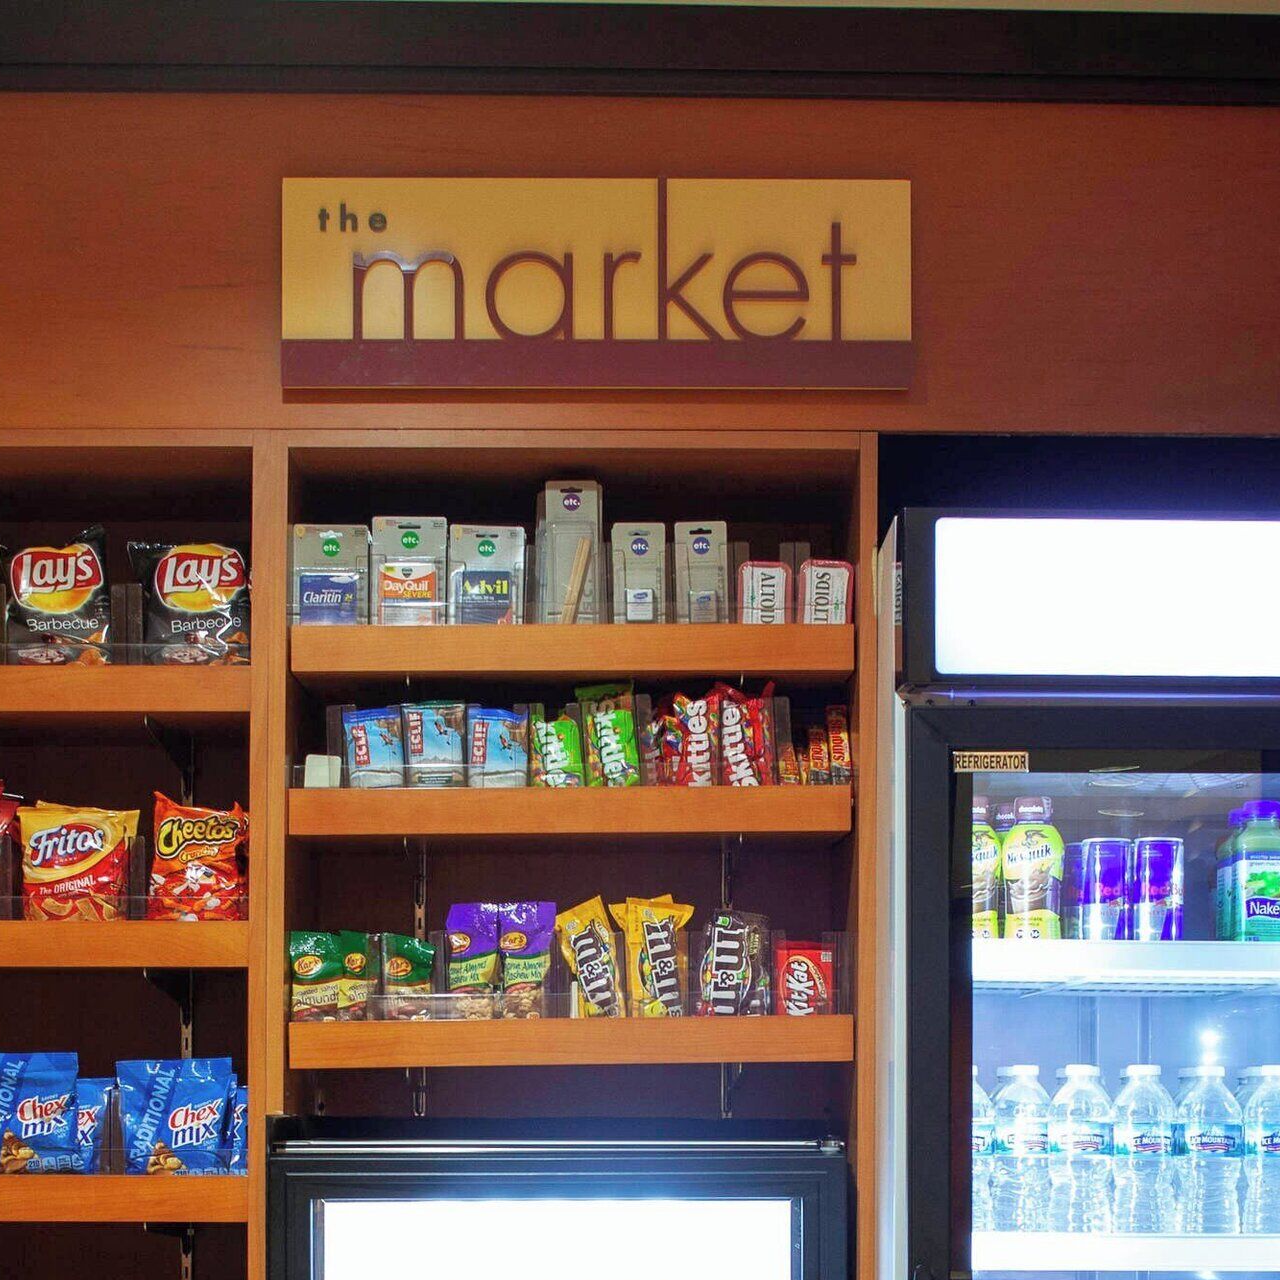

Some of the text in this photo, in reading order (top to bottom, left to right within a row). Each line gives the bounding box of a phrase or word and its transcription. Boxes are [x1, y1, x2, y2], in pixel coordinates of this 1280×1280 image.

[318, 203, 389, 232] the
[352, 177, 857, 340] market
[324, 544, 340, 552] etc.
[20, 554, 94, 593] Lay's
[163, 556, 238, 593] Lay's
[303, 591, 341, 603] Claritin
[384, 581, 428, 593] DayQuil
[463, 580, 508, 595] Advil
[814, 571, 831, 624] LTOIDS
[27, 617, 99, 631] Barbecue
[171, 618, 241, 633] Barbecue
[687, 700, 712, 786] kittles
[955, 755, 1025, 769] REFRIGERATOR
[30, 826, 103, 865] Fritos
[157, 816, 237, 858] Cheetos
[40, 875, 96, 895] The ORIGINAL
[786, 961, 814, 1016] KitKat
[18, 1096, 69, 1121] Chex
[169, 1100, 221, 1130] Chex
[22, 1117, 67, 1138] mix
[173, 1120, 217, 1147] mix
[1263, 1137, 1272, 1145] ICE
